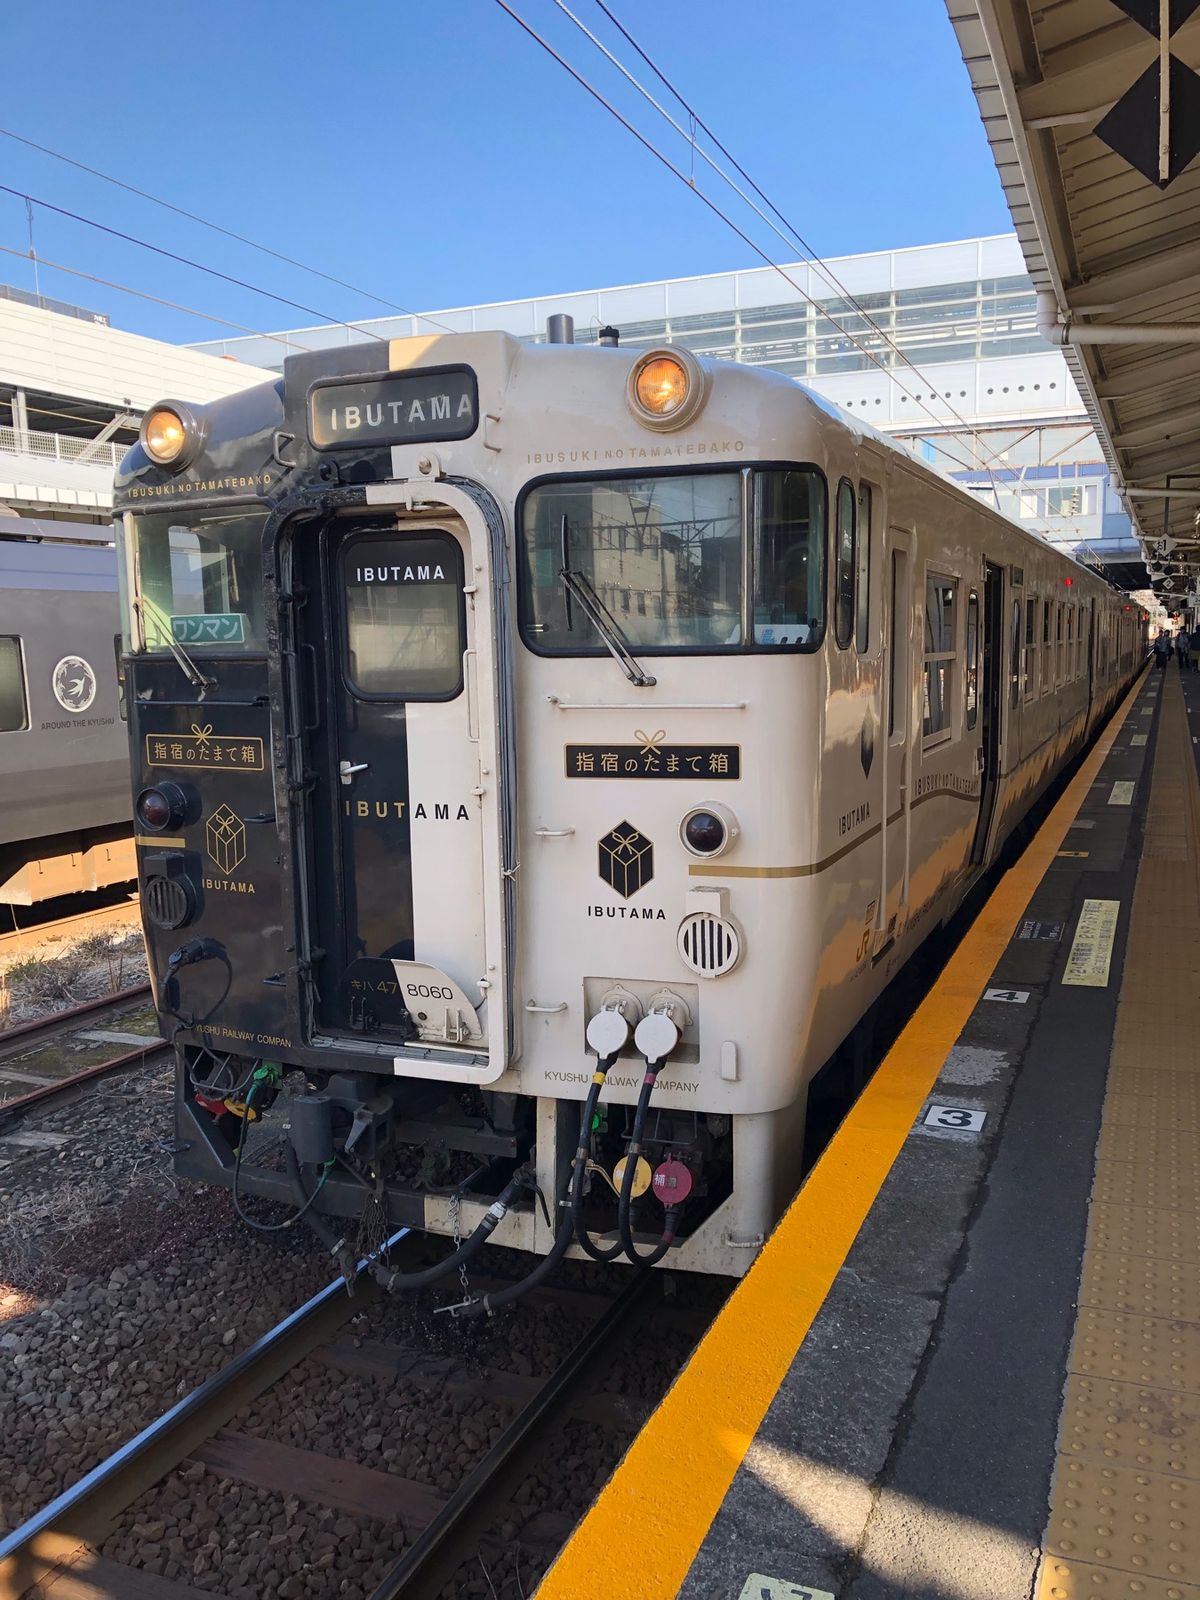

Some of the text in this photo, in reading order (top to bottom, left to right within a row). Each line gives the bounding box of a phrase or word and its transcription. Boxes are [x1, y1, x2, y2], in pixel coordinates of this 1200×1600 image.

[330, 393, 475, 431] IBUTAMA
[527, 440, 744, 465] IBUSUKI NO TAMATEBAKO
[128, 474, 271, 498] IBUSUKI NO TAMATEBAKO
[356, 565, 446, 582] IBUTAMA
[172, 618, 239, 640] ワンマン
[41, 721, 71, 730] AROUND
[154, 742, 256, 763] 指宿のたまて箱
[575, 752, 729, 773] 指宿のたまて箱
[345, 801, 470, 821] IBUTAMA
[838, 801, 871, 837] IBUTAMA
[201, 879, 256, 894] IBUTAMA
[587, 906, 666, 920] IBUTAMA
[856, 929, 870, 962] JR
[406, 984, 454, 1000] 8060
[992, 992, 1020, 1001] 4
[191, 1023, 294, 1048] YUSHU RAILWAY COMPAN
[544, 1071, 589, 1083] KYUSHU
[650, 1081, 700, 1093] OMPANY
[937, 1109, 973, 1127] 3
